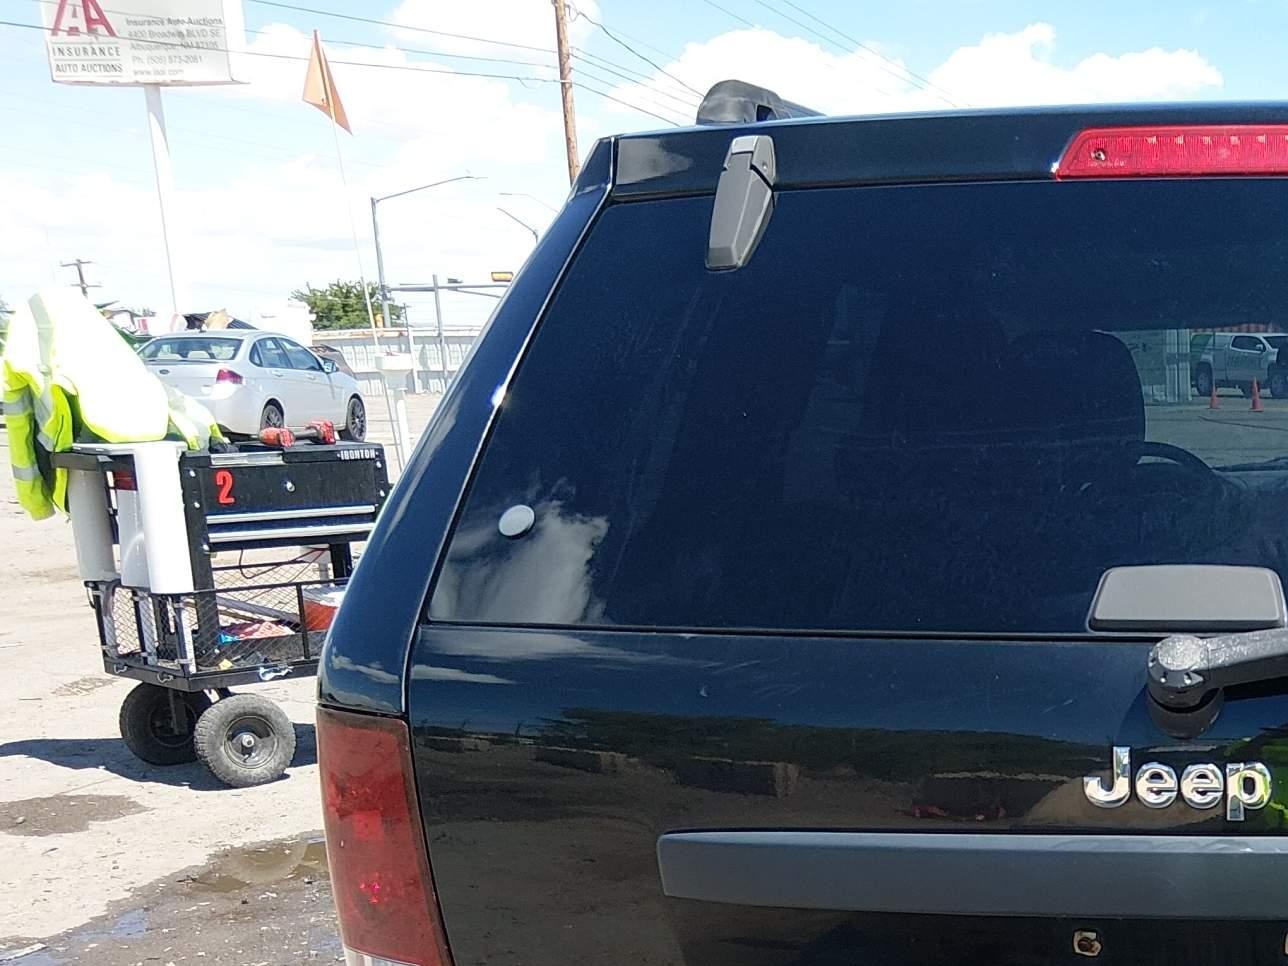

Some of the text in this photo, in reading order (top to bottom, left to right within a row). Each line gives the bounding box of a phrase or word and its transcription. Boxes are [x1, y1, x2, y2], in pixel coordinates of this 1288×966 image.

[52, 46, 121, 57] INSURANCE
[55, 63, 123, 73] AUTO AUCTIONS
[215, 470, 236, 505] 2
[1083, 746, 1273, 822] Jeep
